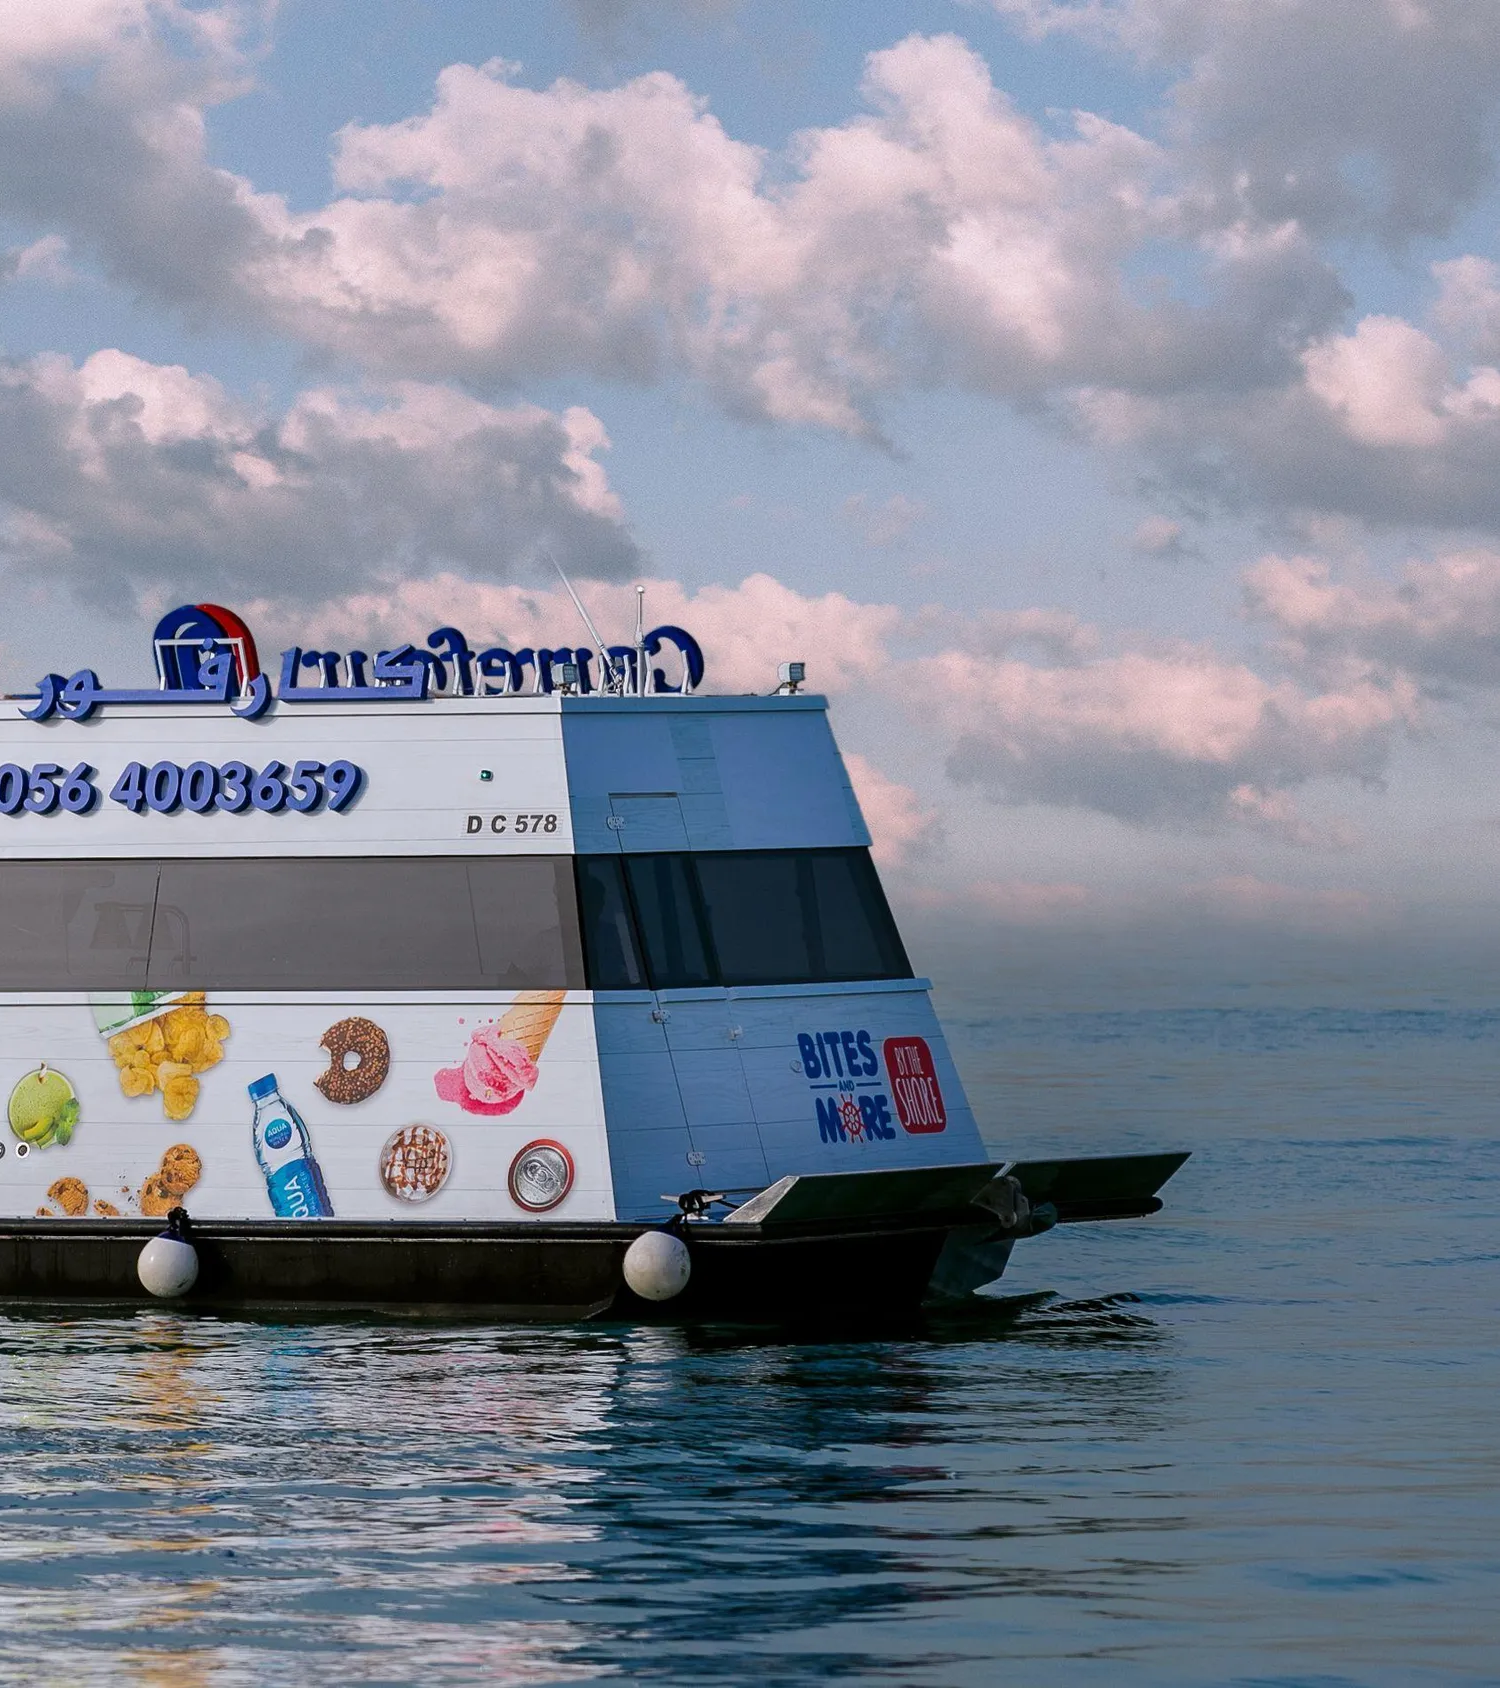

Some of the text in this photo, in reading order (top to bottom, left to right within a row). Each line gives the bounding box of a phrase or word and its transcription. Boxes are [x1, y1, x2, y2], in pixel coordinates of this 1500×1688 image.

[109, 759, 364, 816] 4003659
[466, 814, 558, 834] D C 578
[797, 1029, 879, 1079] BITES
[894, 1046, 924, 1076] BY THE
[837, 1080, 855, 1092] AND
[895, 1077, 943, 1126] SHORE
[267, 1122, 288, 1137] AQUA
[284, 1175, 309, 1217] QUA
